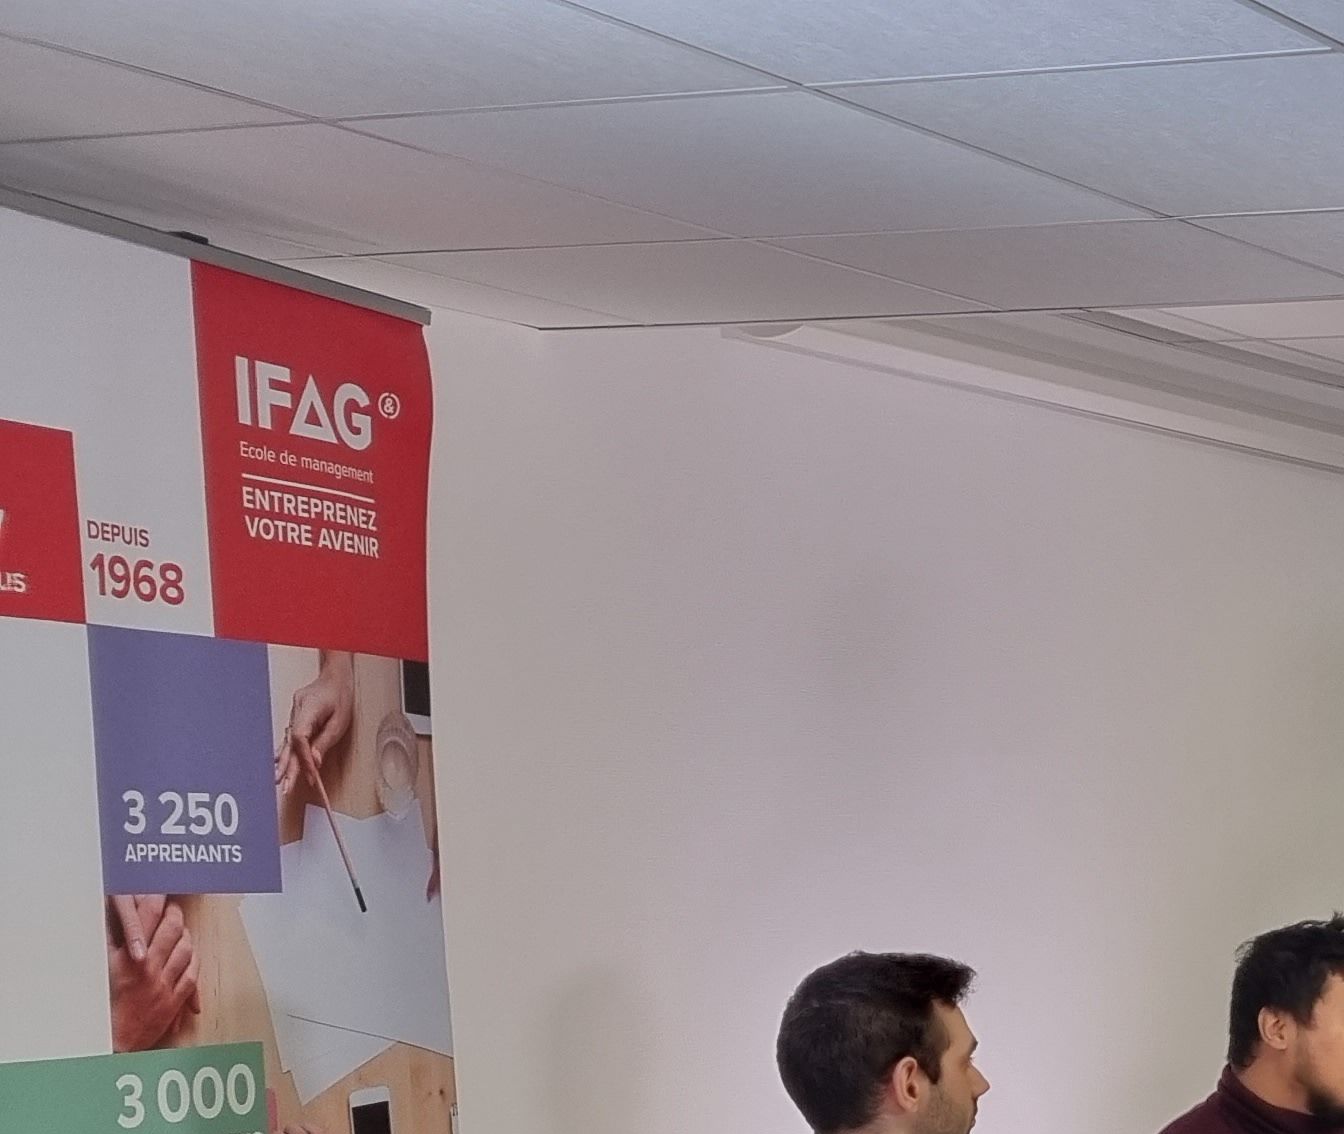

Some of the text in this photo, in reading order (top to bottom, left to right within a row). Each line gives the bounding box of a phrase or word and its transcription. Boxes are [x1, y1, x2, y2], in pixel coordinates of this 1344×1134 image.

[235, 355, 372, 451] IFAG
[240, 441, 374, 484] Ecole de management
[242, 486, 378, 531] ENTREPRENEZ
[86, 519, 150, 548] DEPUIS
[245, 515, 379, 559] VOTRE AVENIR
[90, 552, 185, 606] 1968
[122, 790, 239, 836] 3 250
[125, 843, 242, 863] APPRENANTS
[115, 1063, 256, 1129] 3 000
